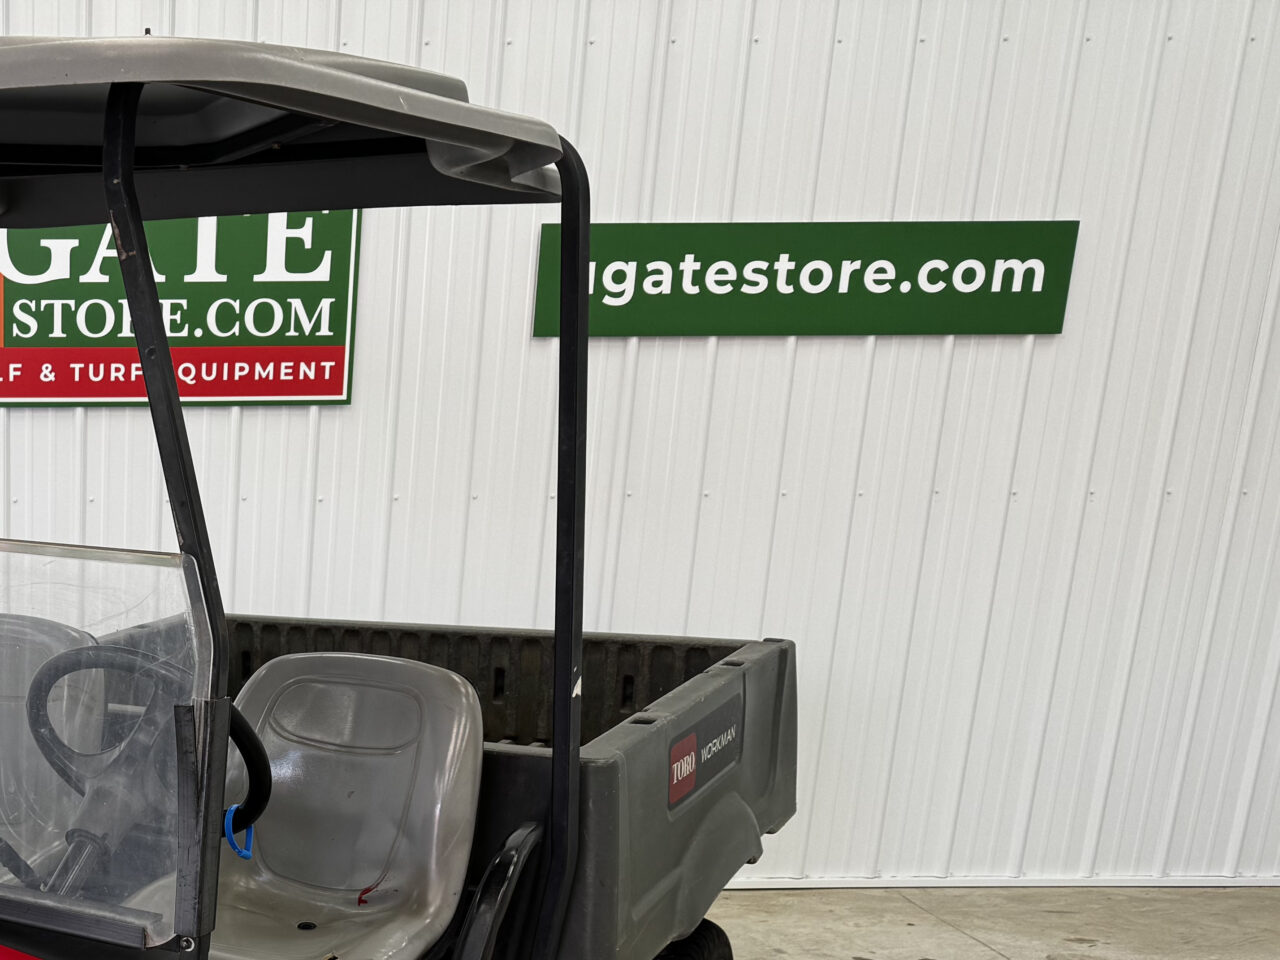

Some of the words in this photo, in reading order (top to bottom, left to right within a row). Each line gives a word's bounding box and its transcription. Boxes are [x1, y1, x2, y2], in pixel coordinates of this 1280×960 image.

[586, 253, 1046, 306] gatestore.com
[12, 297, 336, 338] STOE.COM
[39, 363, 56, 382] &
[70, 363, 144, 382] TURF
[177, 361, 336, 385] QUIPMENT
[672, 751, 696, 785] TORO
[700, 724, 737, 763] WORKMAN
